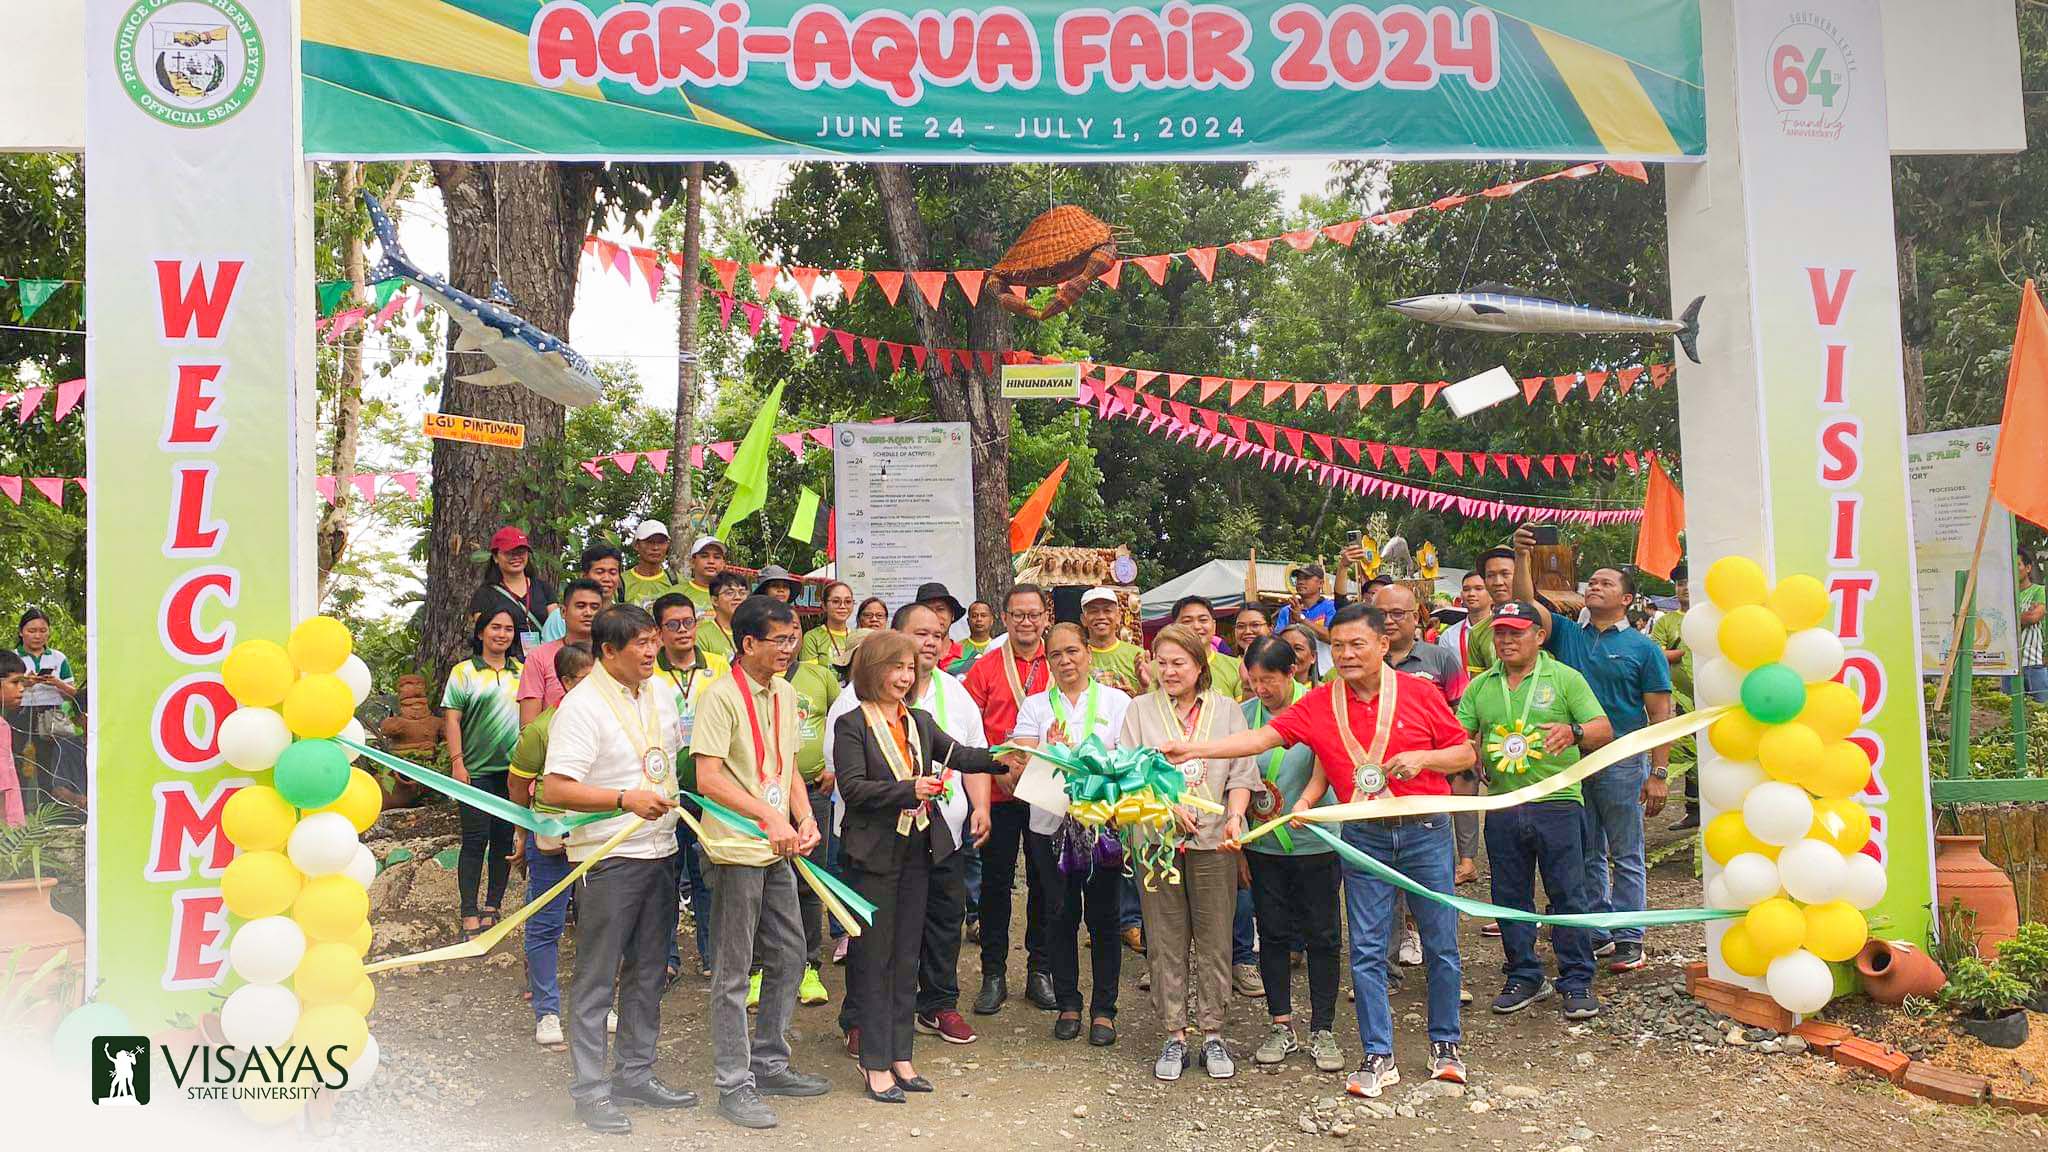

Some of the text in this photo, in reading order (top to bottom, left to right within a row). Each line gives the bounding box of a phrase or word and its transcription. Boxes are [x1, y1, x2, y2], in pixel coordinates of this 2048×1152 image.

[119, 6, 149, 82] PROVINCE
[244, 37, 259, 87] LEYTE
[1276, 11, 1491, 83] 2024
[140, 95, 241, 123] OFFICIAL SEAL
[817, 117, 903, 138] JUNE
[924, 117, 966, 138] 24
[1015, 117, 1094, 139] JULY
[1113, 117, 1140, 142] 1,
[1158, 117, 1245, 138] 2024
[1006, 379, 1073, 388] HINUNDAYAN
[427, 414, 519, 436] LGU PINTUYAN
[153, 260, 243, 982] WELCOME
